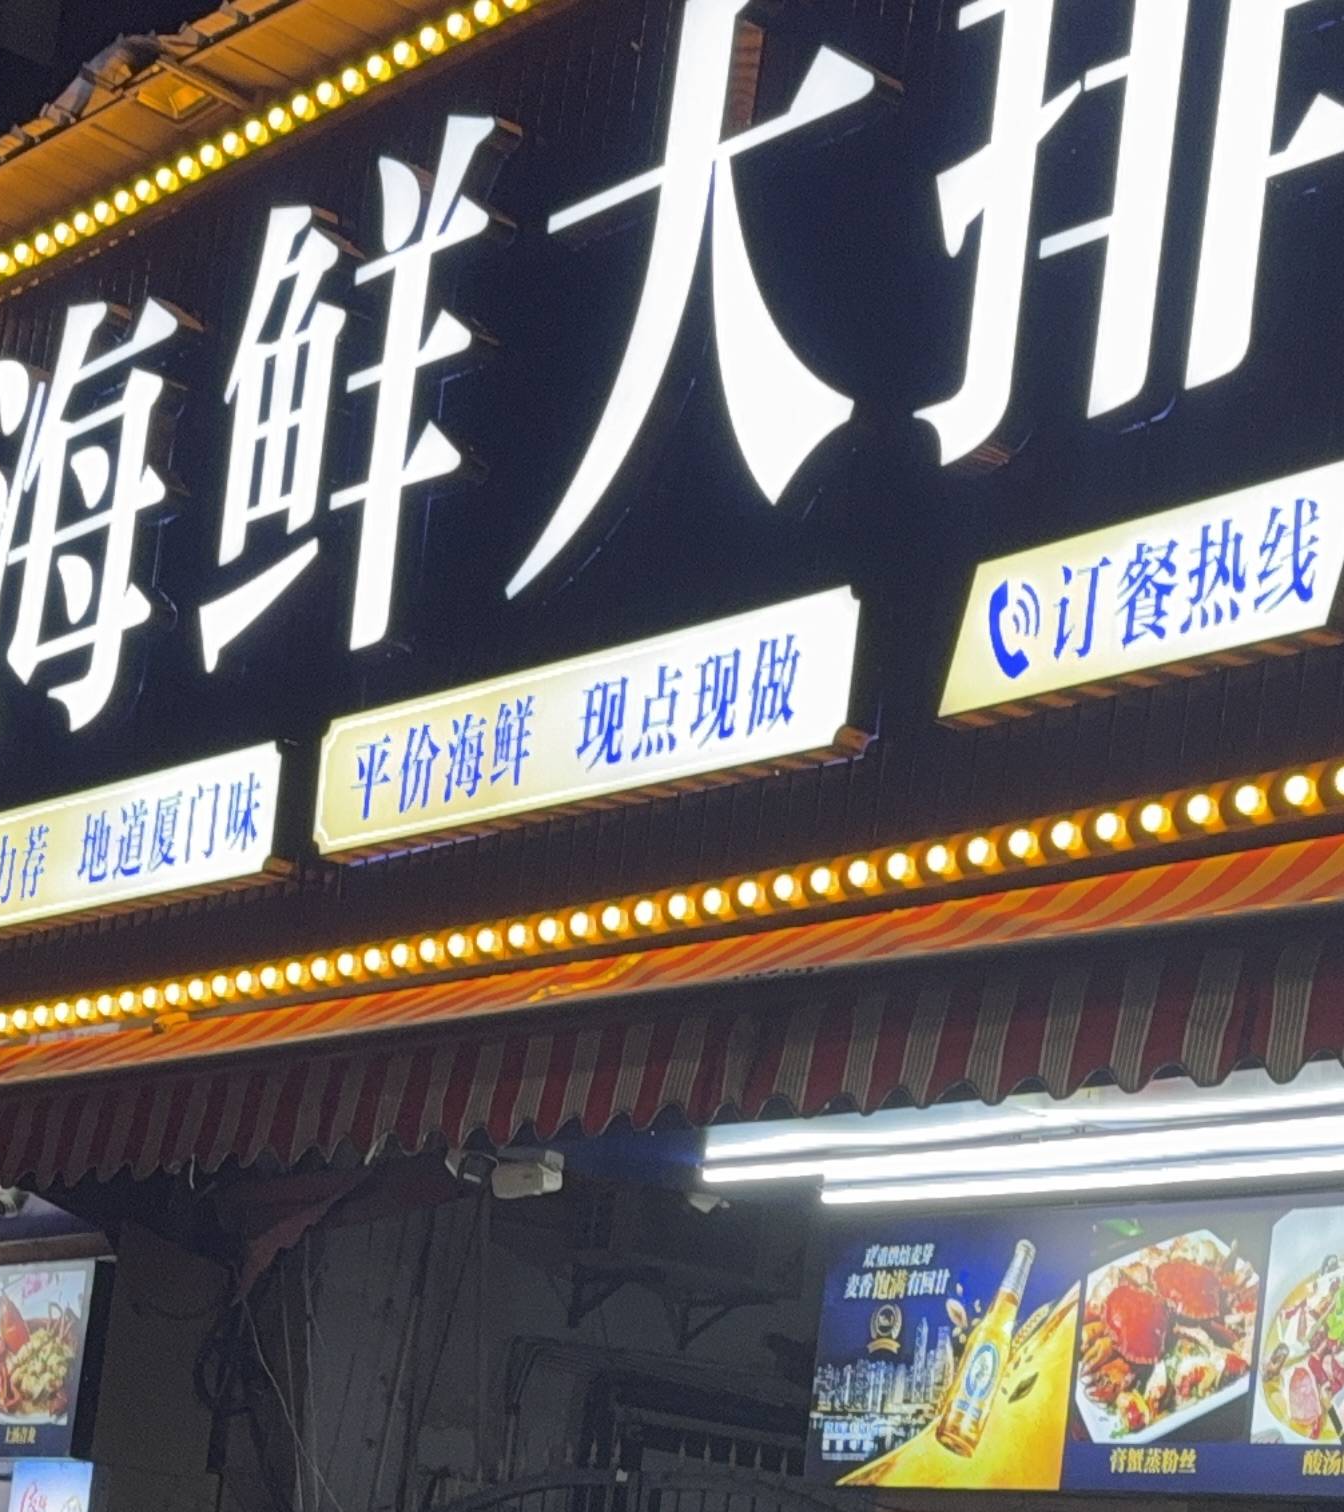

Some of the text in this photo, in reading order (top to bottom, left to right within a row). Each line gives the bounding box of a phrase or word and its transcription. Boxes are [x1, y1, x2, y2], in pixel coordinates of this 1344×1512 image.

[1051, 498, 1322, 660] 订餐热线
[350, 634, 801, 821] 平价海鲜 现点现做
[76, 772, 262, 884] 地道厦门味
[1108, 1447, 1197, 1475] 膏蟹蒸粉丝
